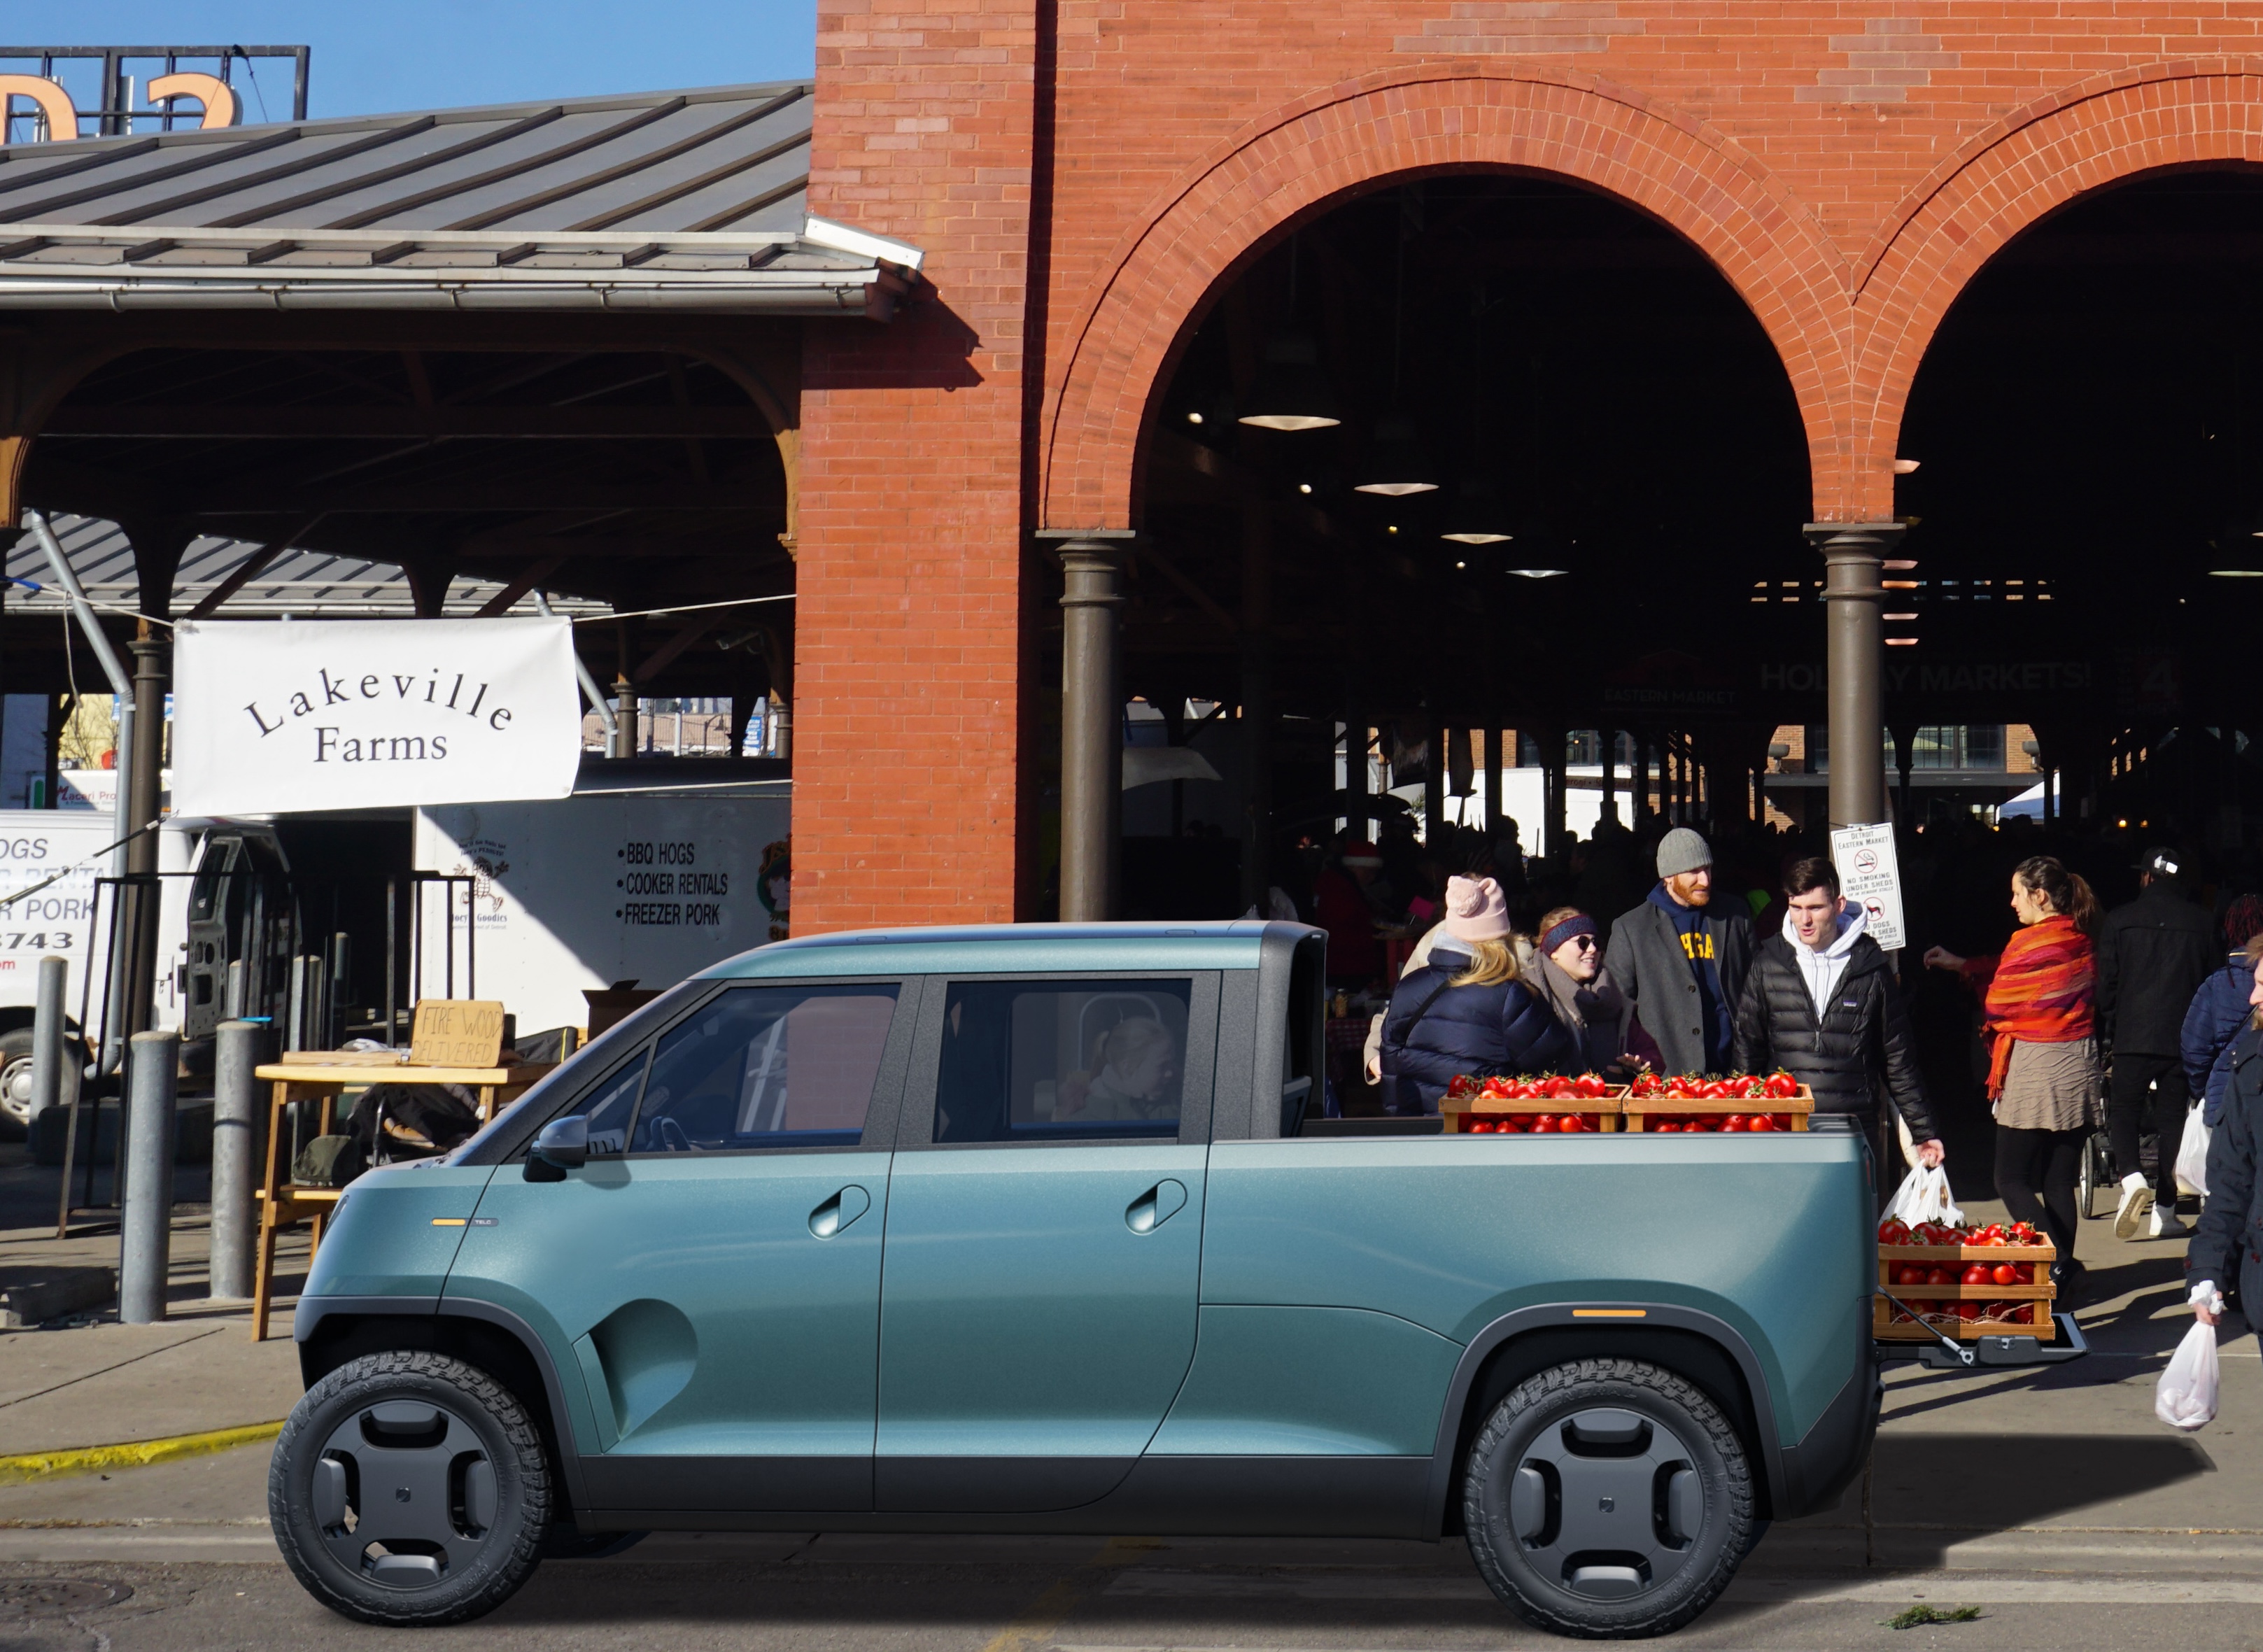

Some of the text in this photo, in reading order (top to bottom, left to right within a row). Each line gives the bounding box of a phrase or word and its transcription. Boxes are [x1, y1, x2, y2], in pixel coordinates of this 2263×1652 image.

[1921, 661, 2091, 691] MARKETS!
[243, 667, 512, 738] Lakeville
[1605, 689, 1736, 705] EASTERN MARKET
[313, 727, 448, 763] Farms
[1838, 836, 1889, 850] EASTERN MARKET
[1851, 831, 1875, 840] DETROIT
[627, 842, 695, 866] BBQ HOGS
[626, 873, 728, 896] COOKER RENTALS
[1846, 879, 1894, 892] UNDER SHEDS
[1859, 872, 1890, 882] SMOKING
[26, 898, 93, 920] PORK
[625, 903, 720, 926] FREEZER PORK
[1878, 927, 1897, 936] SHEDS
[422, 1006, 503, 1039] FIRE WOOD
[411, 1040, 493, 1063] DELIVERED
[333, 1376, 432, 1410] GENERAL
[1535, 1384, 1637, 1418] GENERAL
